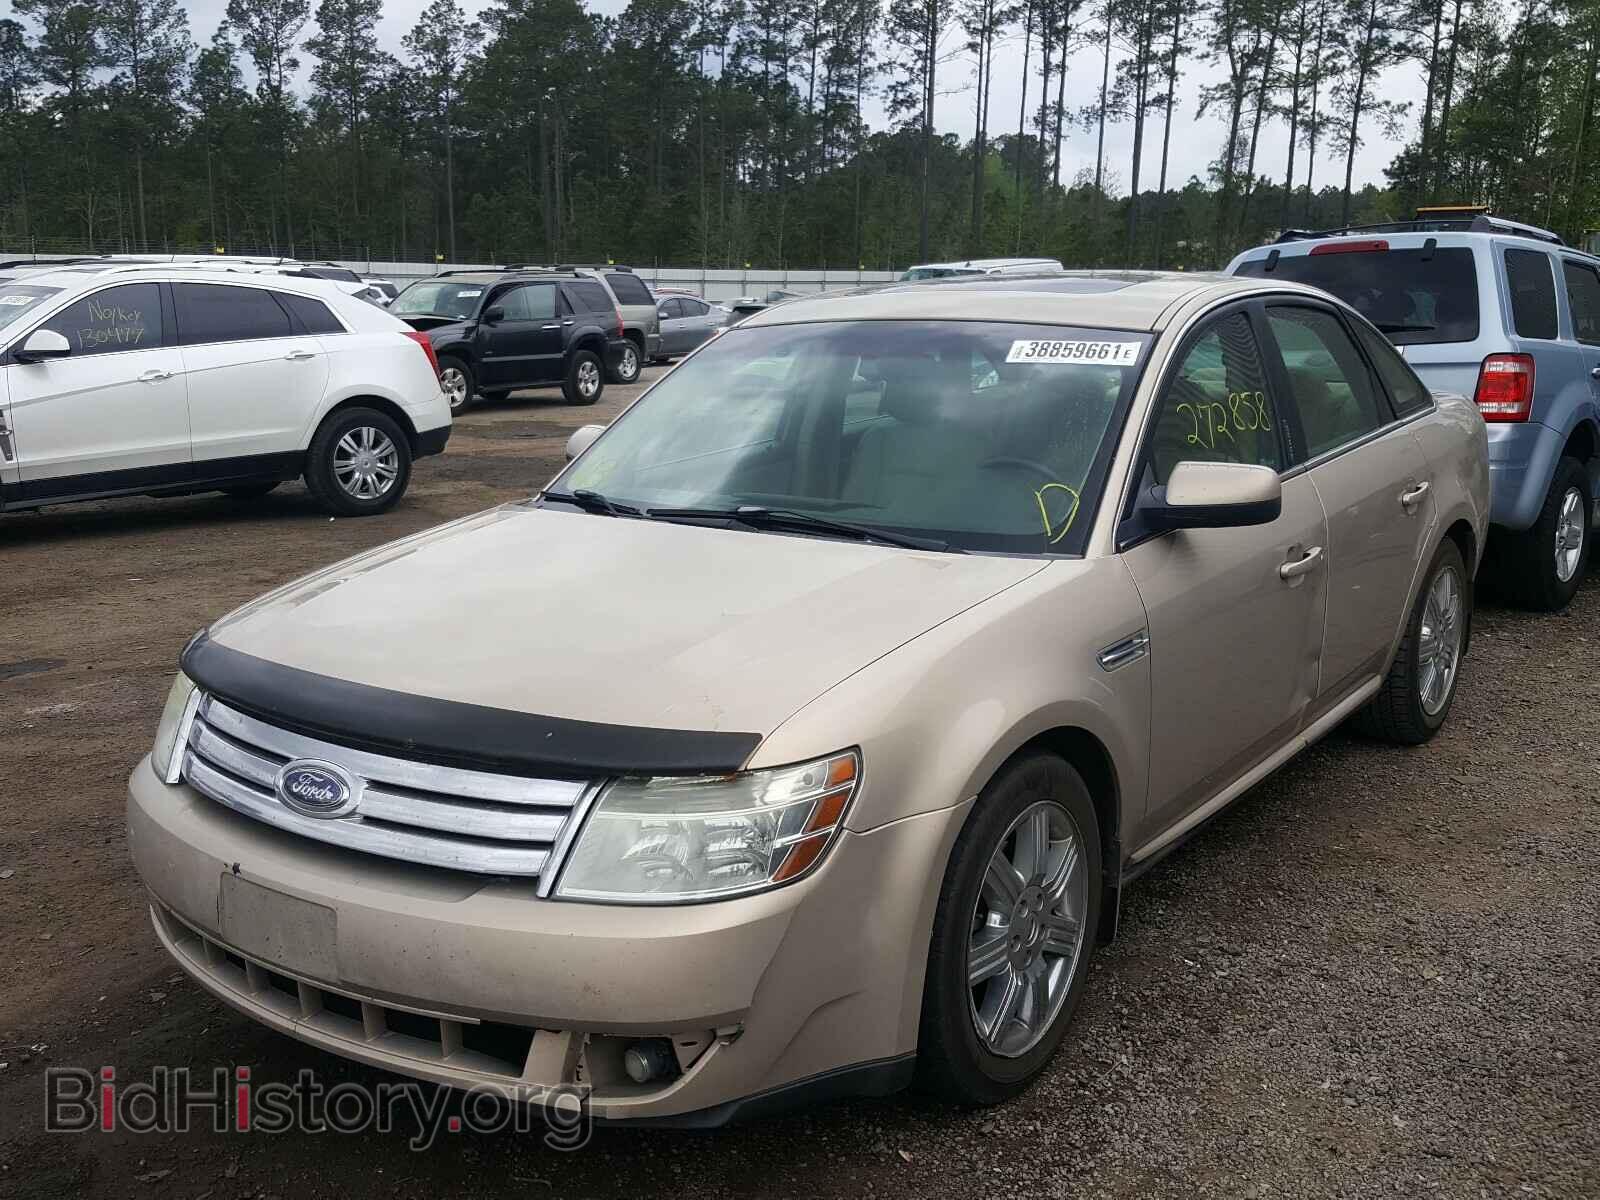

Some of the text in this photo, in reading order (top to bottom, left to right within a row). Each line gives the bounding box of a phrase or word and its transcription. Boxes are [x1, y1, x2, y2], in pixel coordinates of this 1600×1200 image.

[1025, 341, 1121, 360] 38859661
[1176, 391, 1271, 449] 272858
[292, 773, 334, 800] Ford
